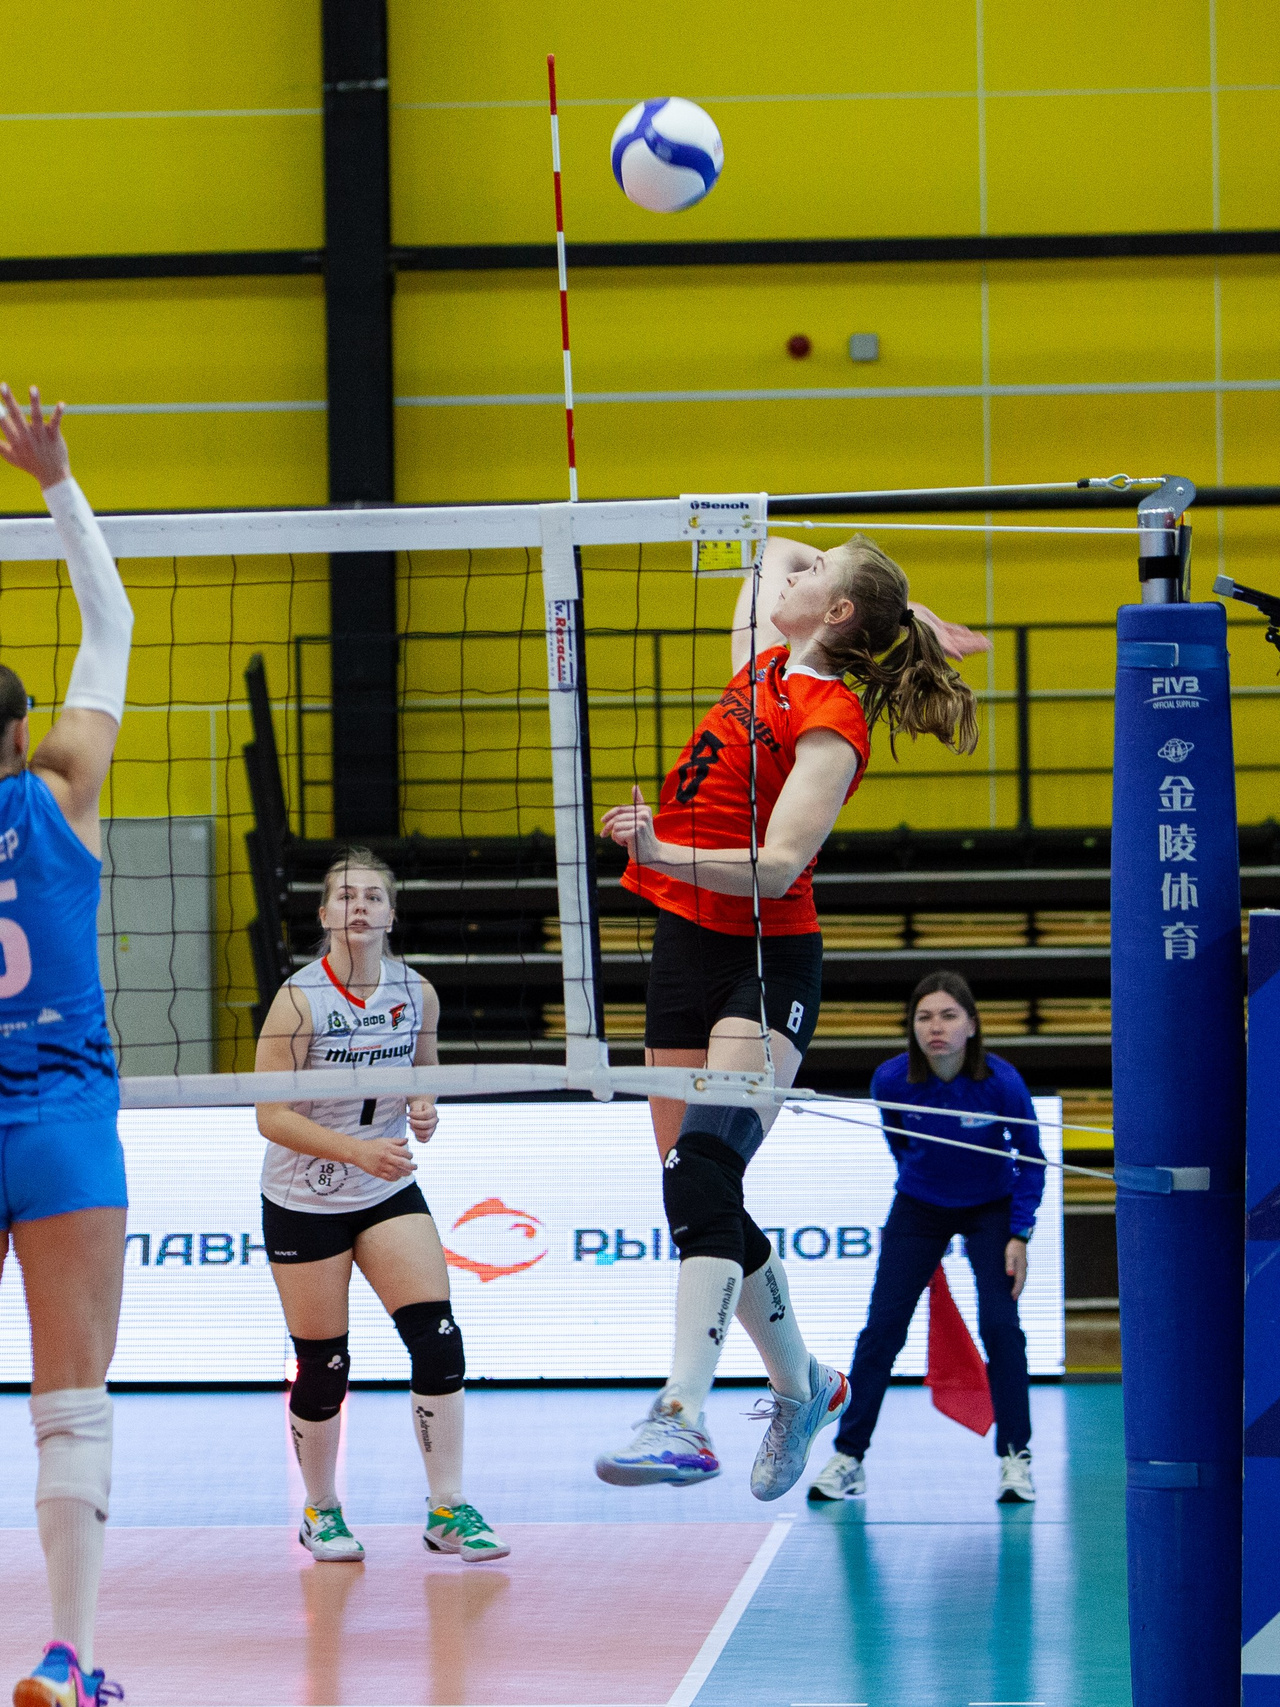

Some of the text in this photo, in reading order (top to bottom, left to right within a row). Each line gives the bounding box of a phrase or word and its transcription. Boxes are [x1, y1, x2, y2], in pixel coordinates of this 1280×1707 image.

[701, 501, 749, 510] Senoh
[1151, 676, 1200, 694] FIVB
[1152, 700, 1200, 710] OFFICIAL SUPPLIER
[675, 730, 725, 804] 8
[1158, 776, 1199, 960] 金陵体育
[363, 1014, 386, 1026] ВФВ
[786, 1000, 805, 1034] 8
[320, 1163, 334, 1174] 18
